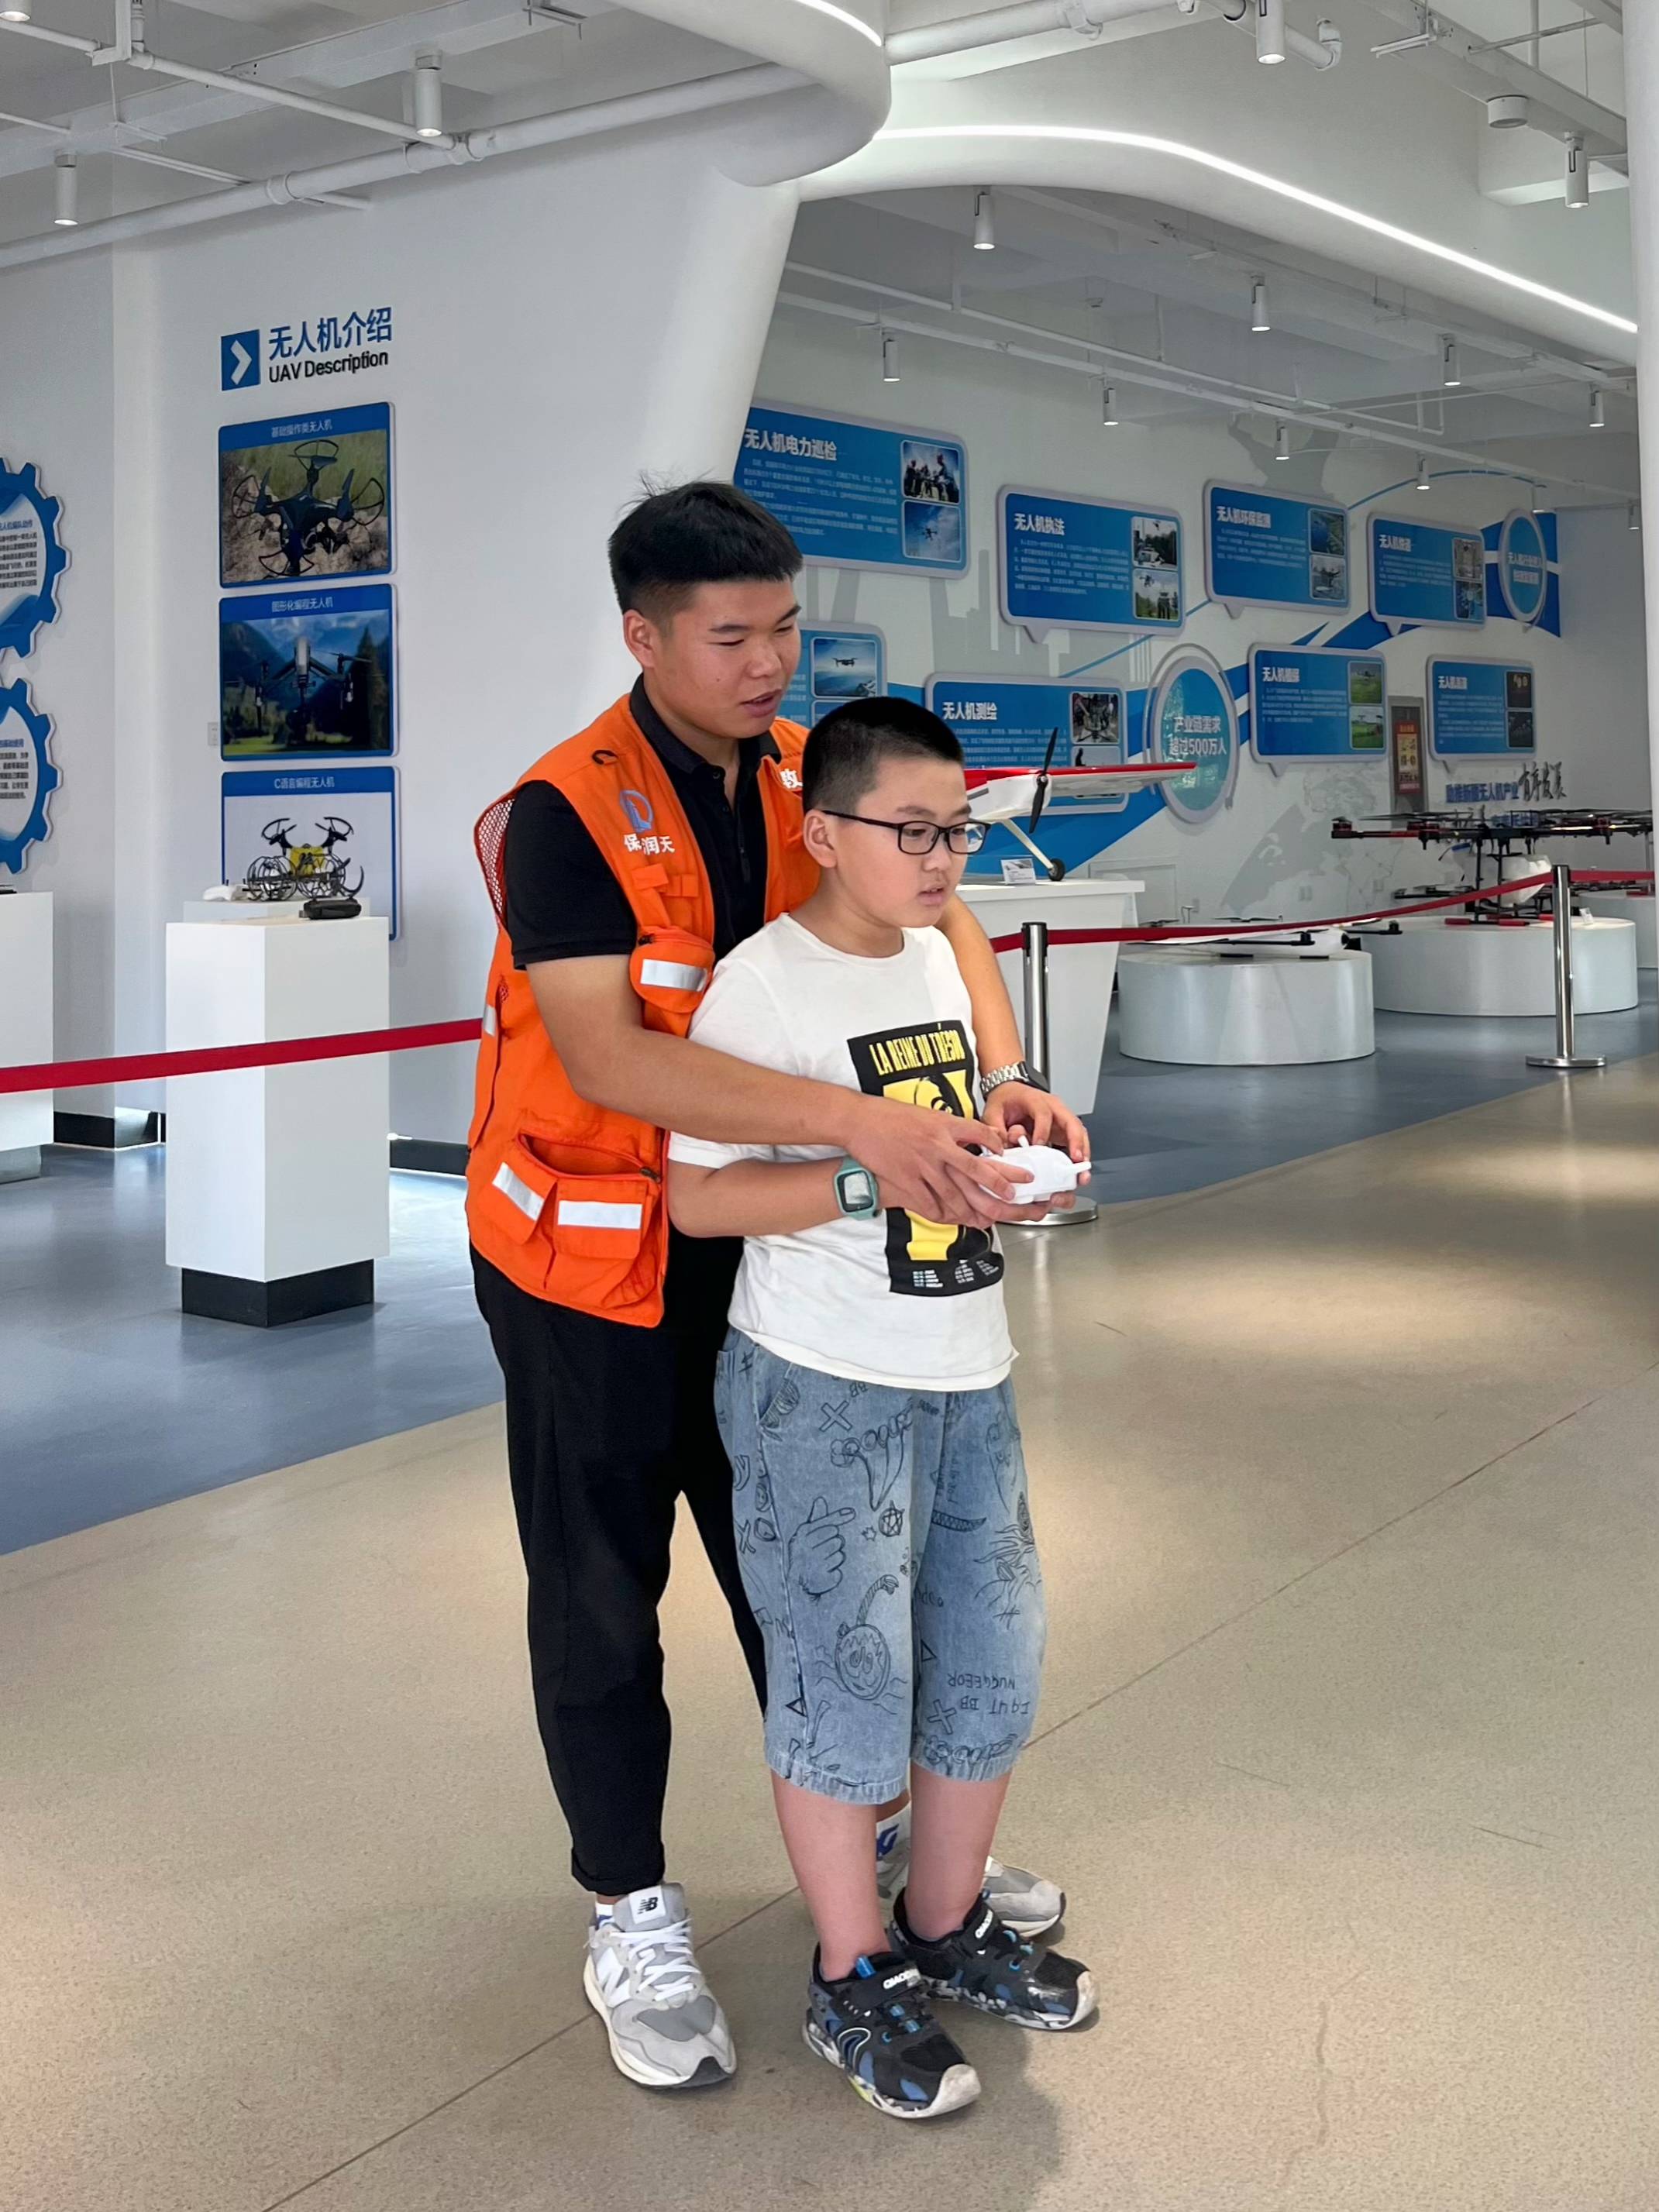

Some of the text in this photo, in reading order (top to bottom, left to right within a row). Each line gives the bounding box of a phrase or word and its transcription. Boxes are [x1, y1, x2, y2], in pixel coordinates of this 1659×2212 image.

[268, 307, 392, 361] 无人机介绍
[269, 352, 388, 383] UAV Description
[744, 428, 838, 461] 无人机电力巡检
[1014, 513, 1065, 536] 无人机执法
[941, 701, 998, 721] 无人机测绘
[1173, 715, 1221, 734] 产业链需求
[1169, 736, 1227, 757] 超过500万人
[623, 833, 676, 855] 保润天
[869, 1042, 893, 1076] LA
[886, 1036, 922, 1072] REINE
